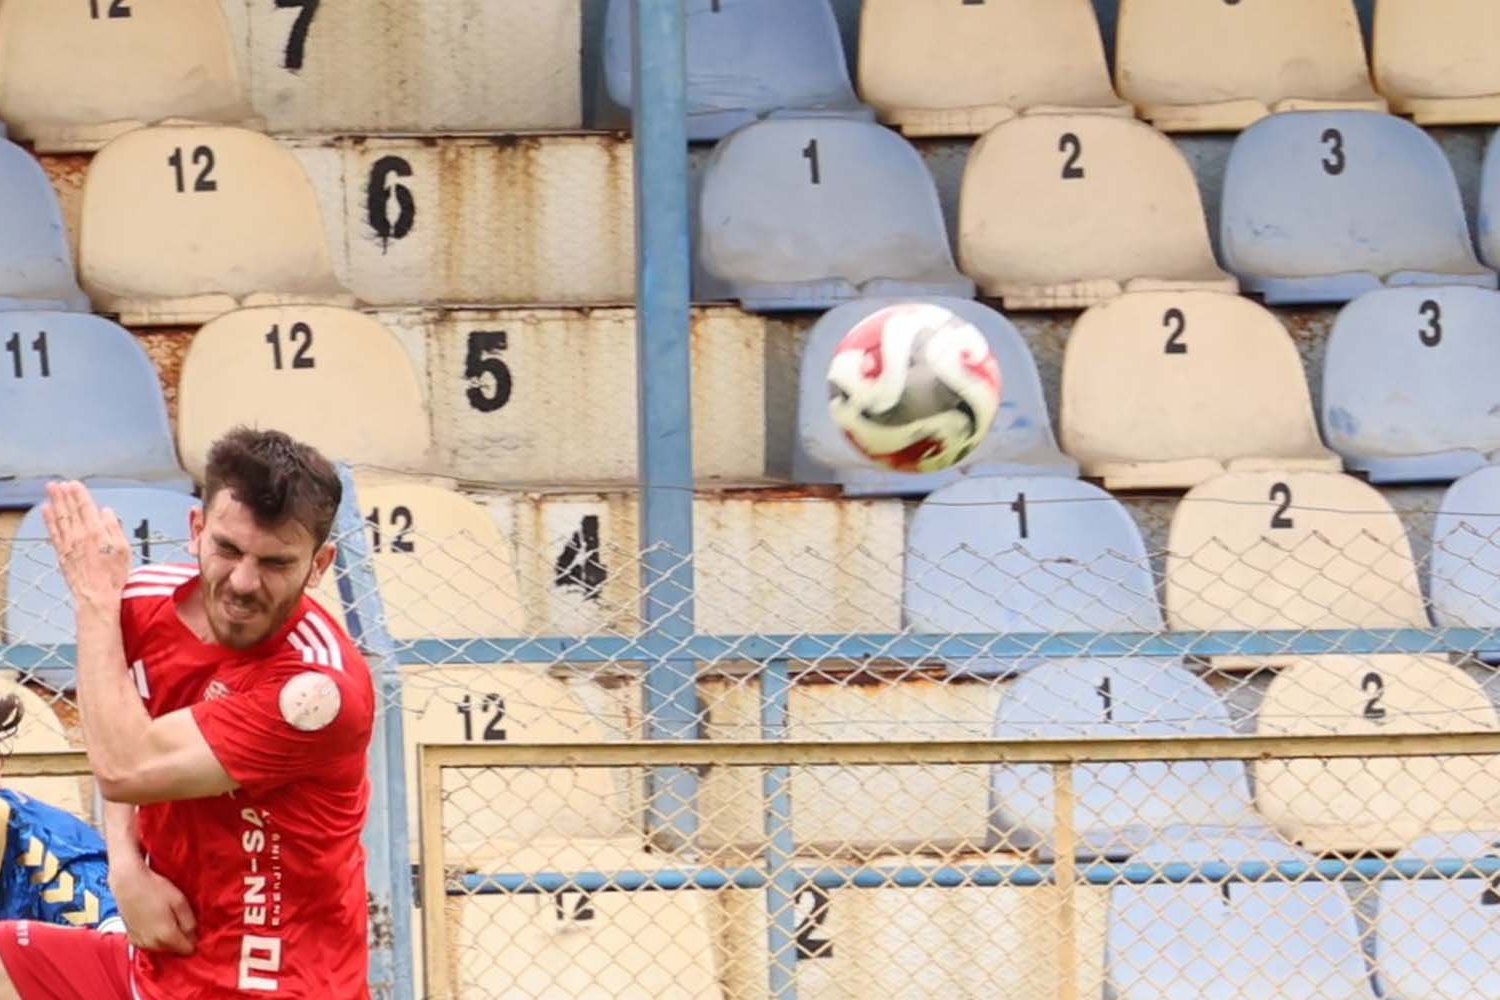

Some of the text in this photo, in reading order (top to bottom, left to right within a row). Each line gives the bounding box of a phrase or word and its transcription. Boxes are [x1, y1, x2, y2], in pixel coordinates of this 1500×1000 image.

[274, 0, 320, 69] 7
[168, 146, 217, 192] 12
[803, 139, 820, 184] 1
[1059, 133, 1084, 179] 2
[1321, 129, 1345, 175] 3
[366, 155, 416, 242] 6
[266, 323, 315, 370] 12
[1163, 309, 1187, 354] 2
[1419, 300, 1442, 347] 3
[6, 332, 50, 378] 11
[465, 331, 512, 412] 5
[1012, 494, 1028, 538] 1
[1270, 483, 1292, 528] 2
[366, 507, 414, 553] 12
[556, 516, 608, 600] 4
[458, 693, 506, 741] 12
[1097, 677, 1112, 720] 1
[1363, 673, 1385, 719] 2
[796, 883, 834, 960] 2
